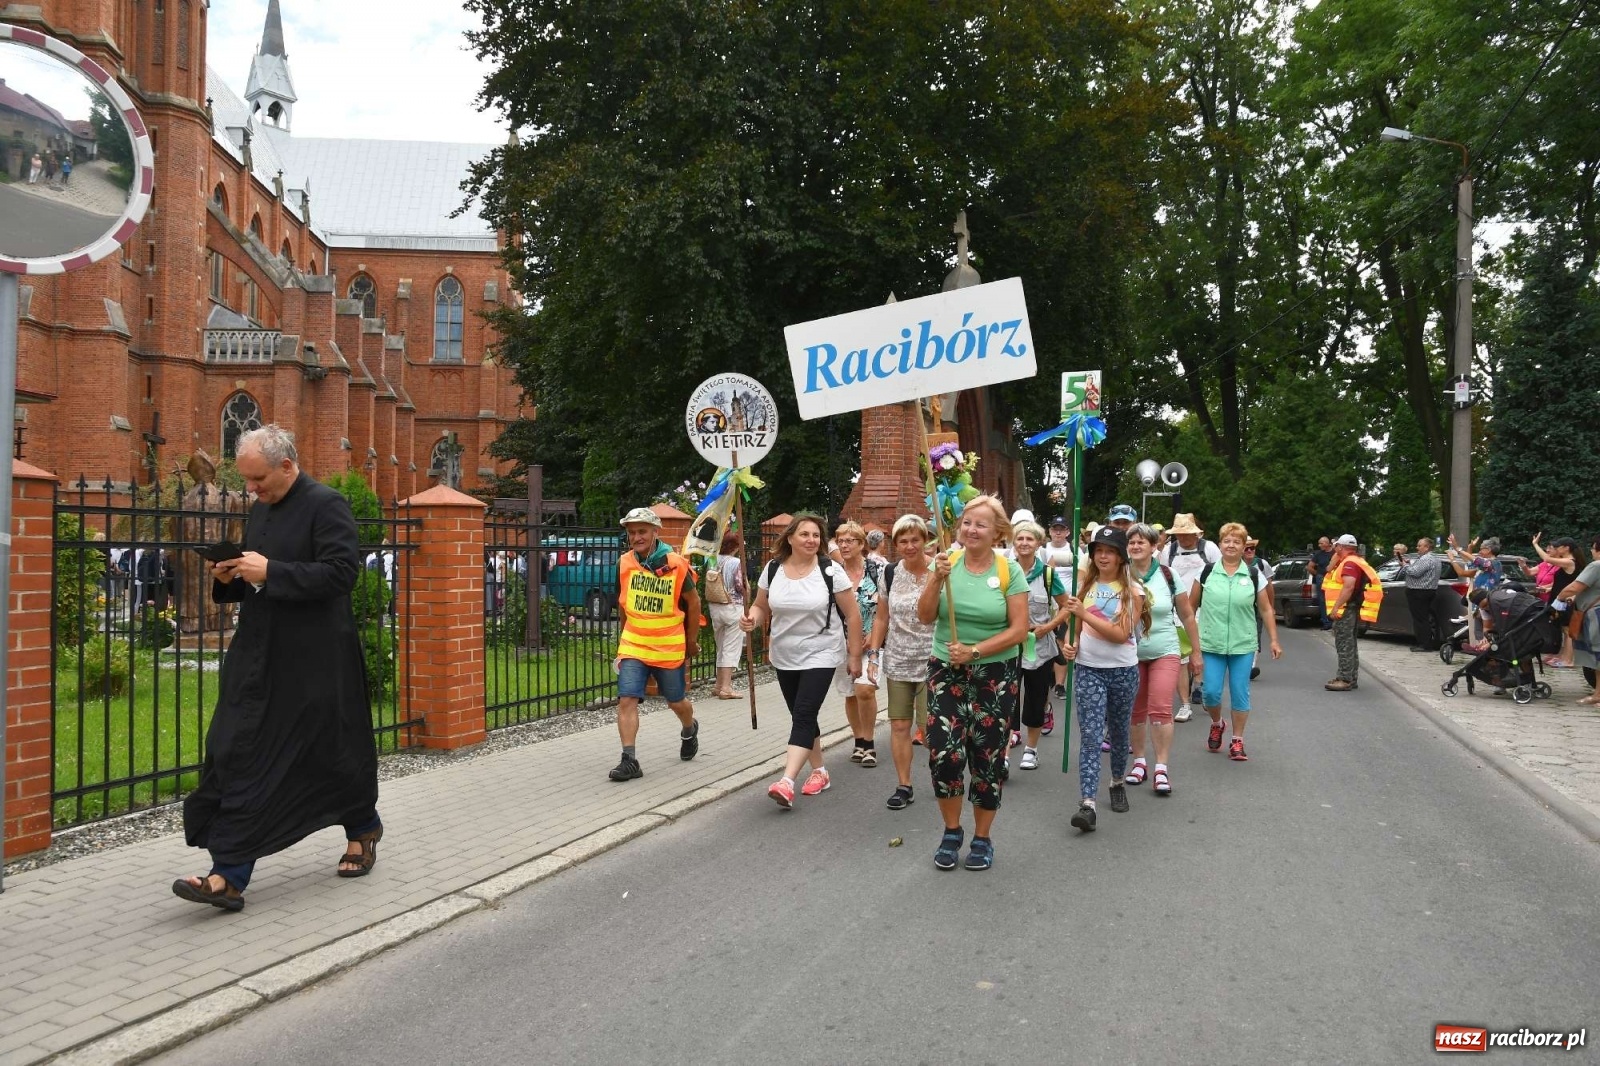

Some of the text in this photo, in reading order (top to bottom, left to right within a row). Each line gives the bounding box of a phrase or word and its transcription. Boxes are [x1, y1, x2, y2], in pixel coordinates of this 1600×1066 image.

[803, 312, 1027, 394] Racibórz
[688, 404, 696, 436] PARAFIA
[725, 376, 761, 395] TOMASZA
[1065, 375, 1087, 410] 5
[702, 433, 767, 449] KIETRZ
[631, 574, 672, 595] KIEROWANIE
[634, 594, 664, 613] RUCHEM
